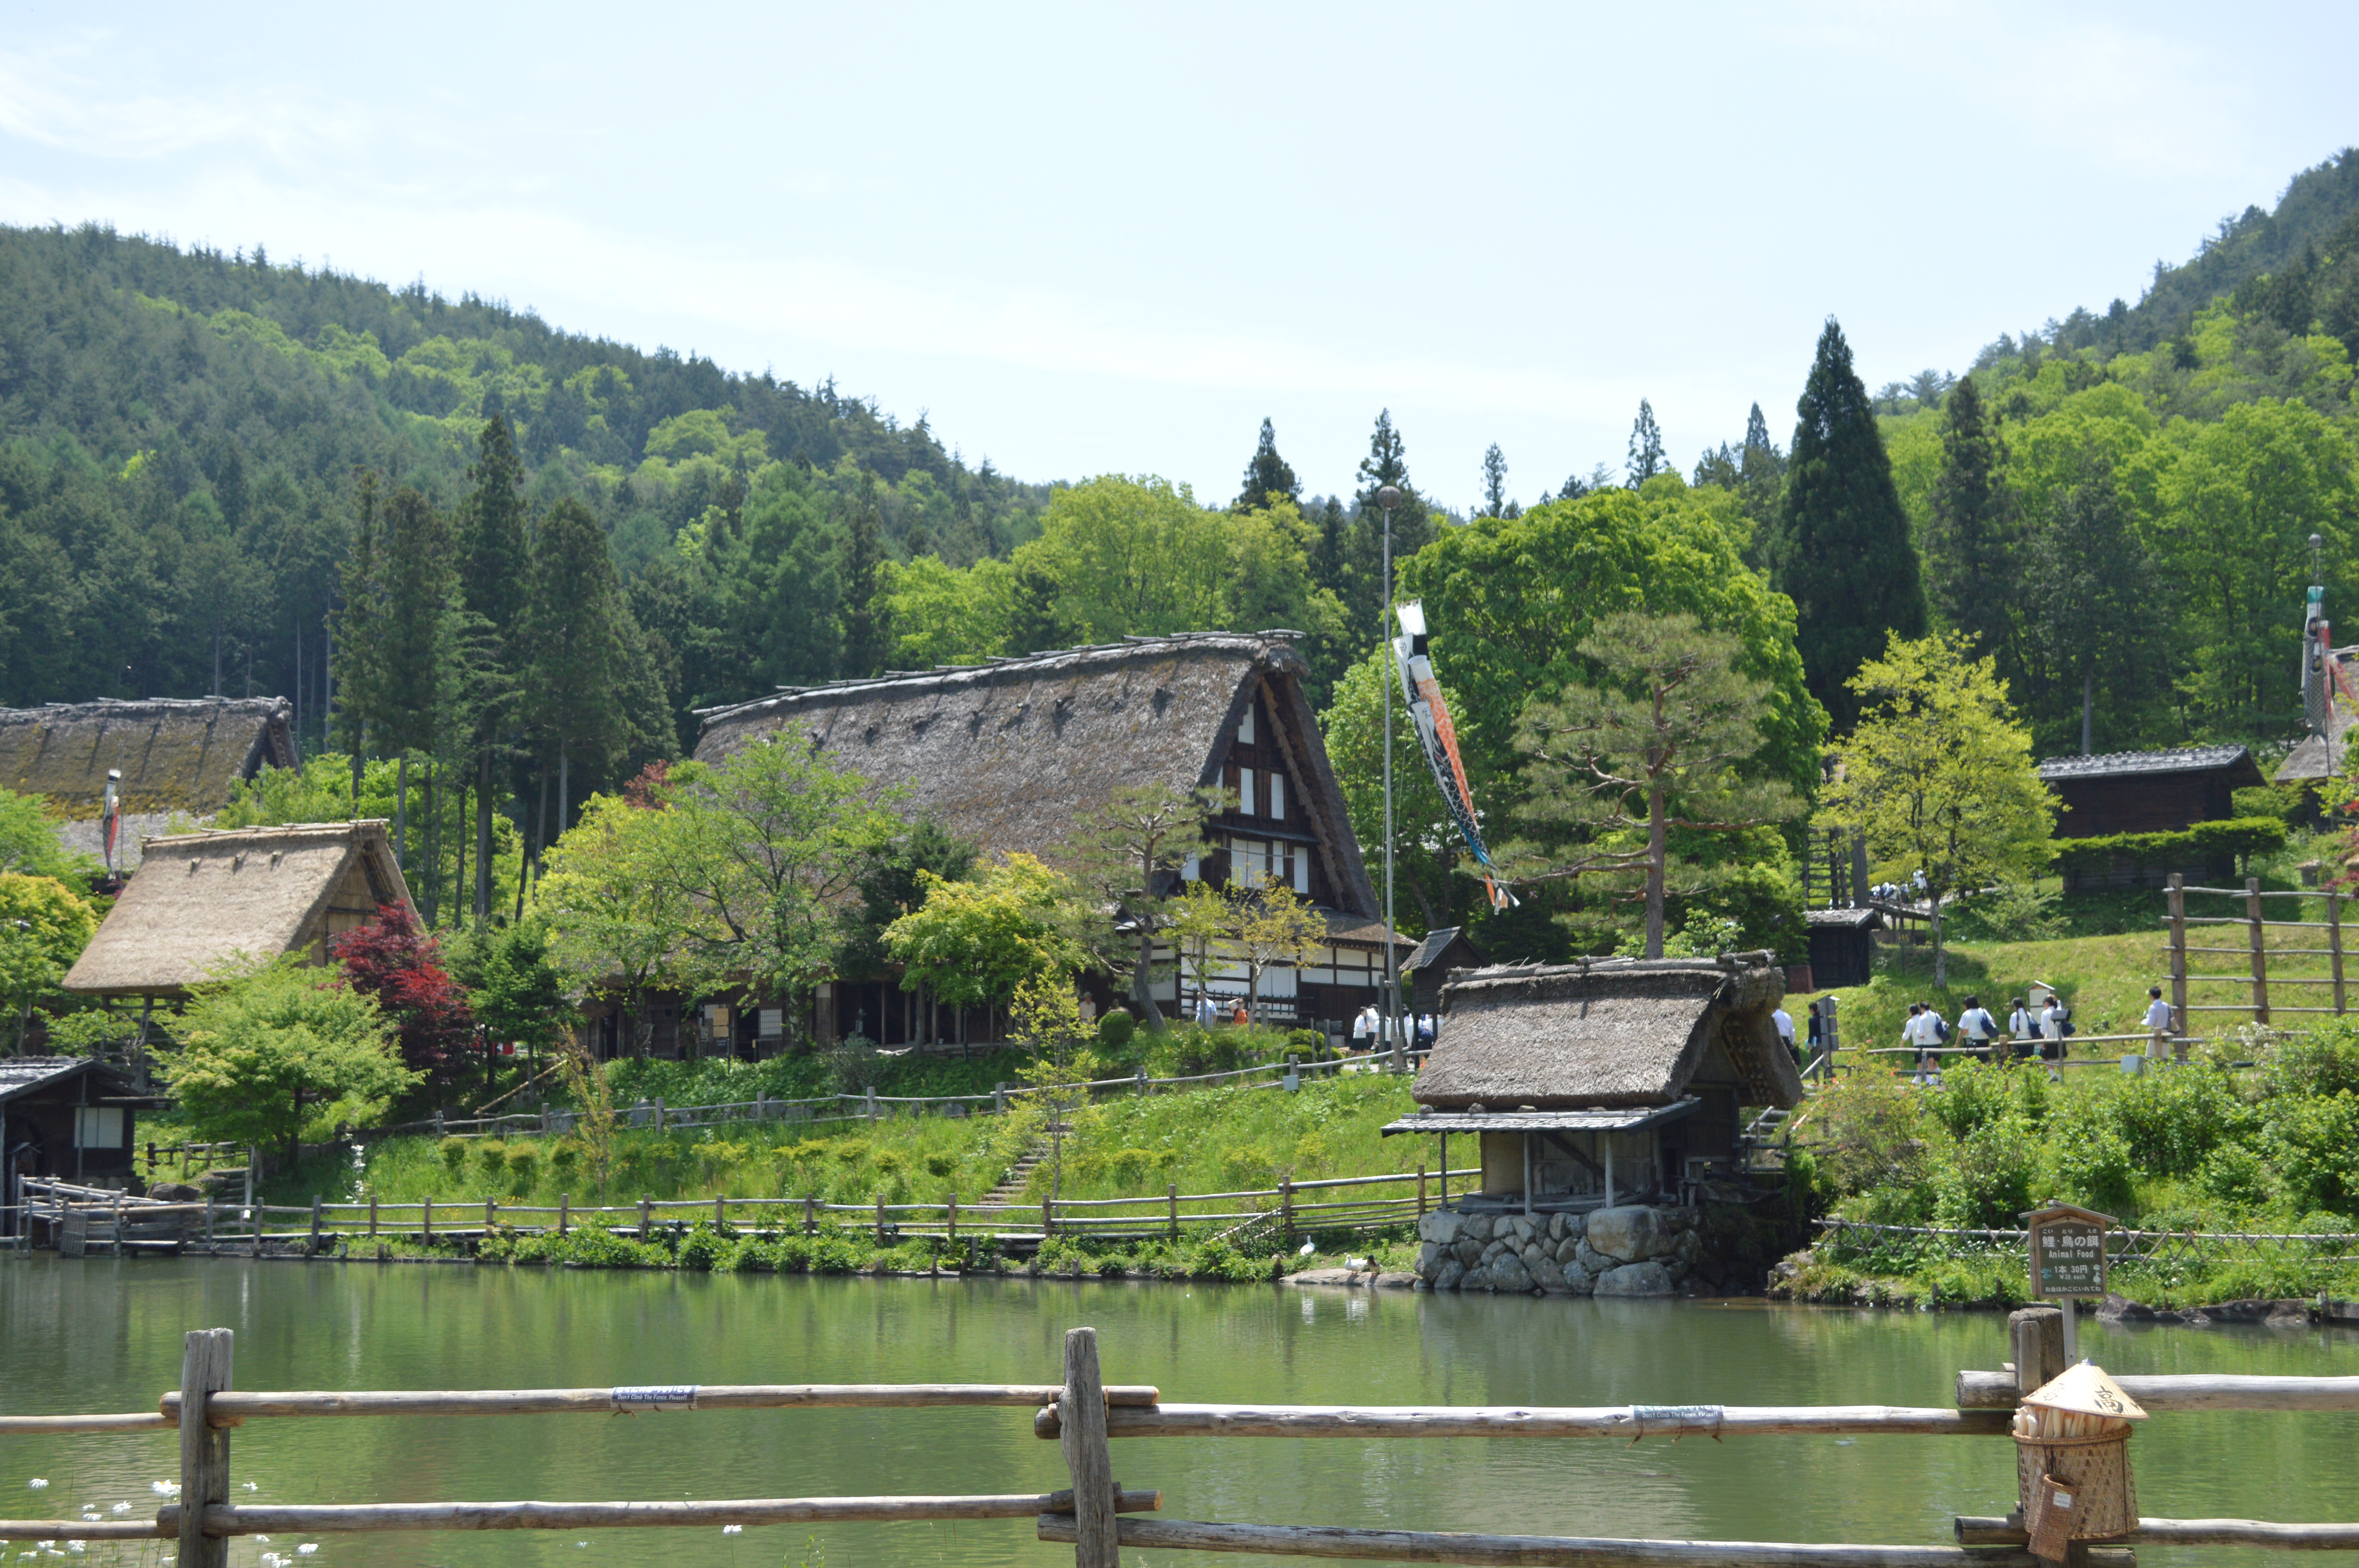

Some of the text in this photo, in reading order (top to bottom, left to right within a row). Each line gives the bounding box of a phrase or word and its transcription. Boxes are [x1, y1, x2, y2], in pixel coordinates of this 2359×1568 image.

[2049, 1249, 2094, 1258] Animal Food
[2054, 1265, 2087, 1274] 1本 30円
